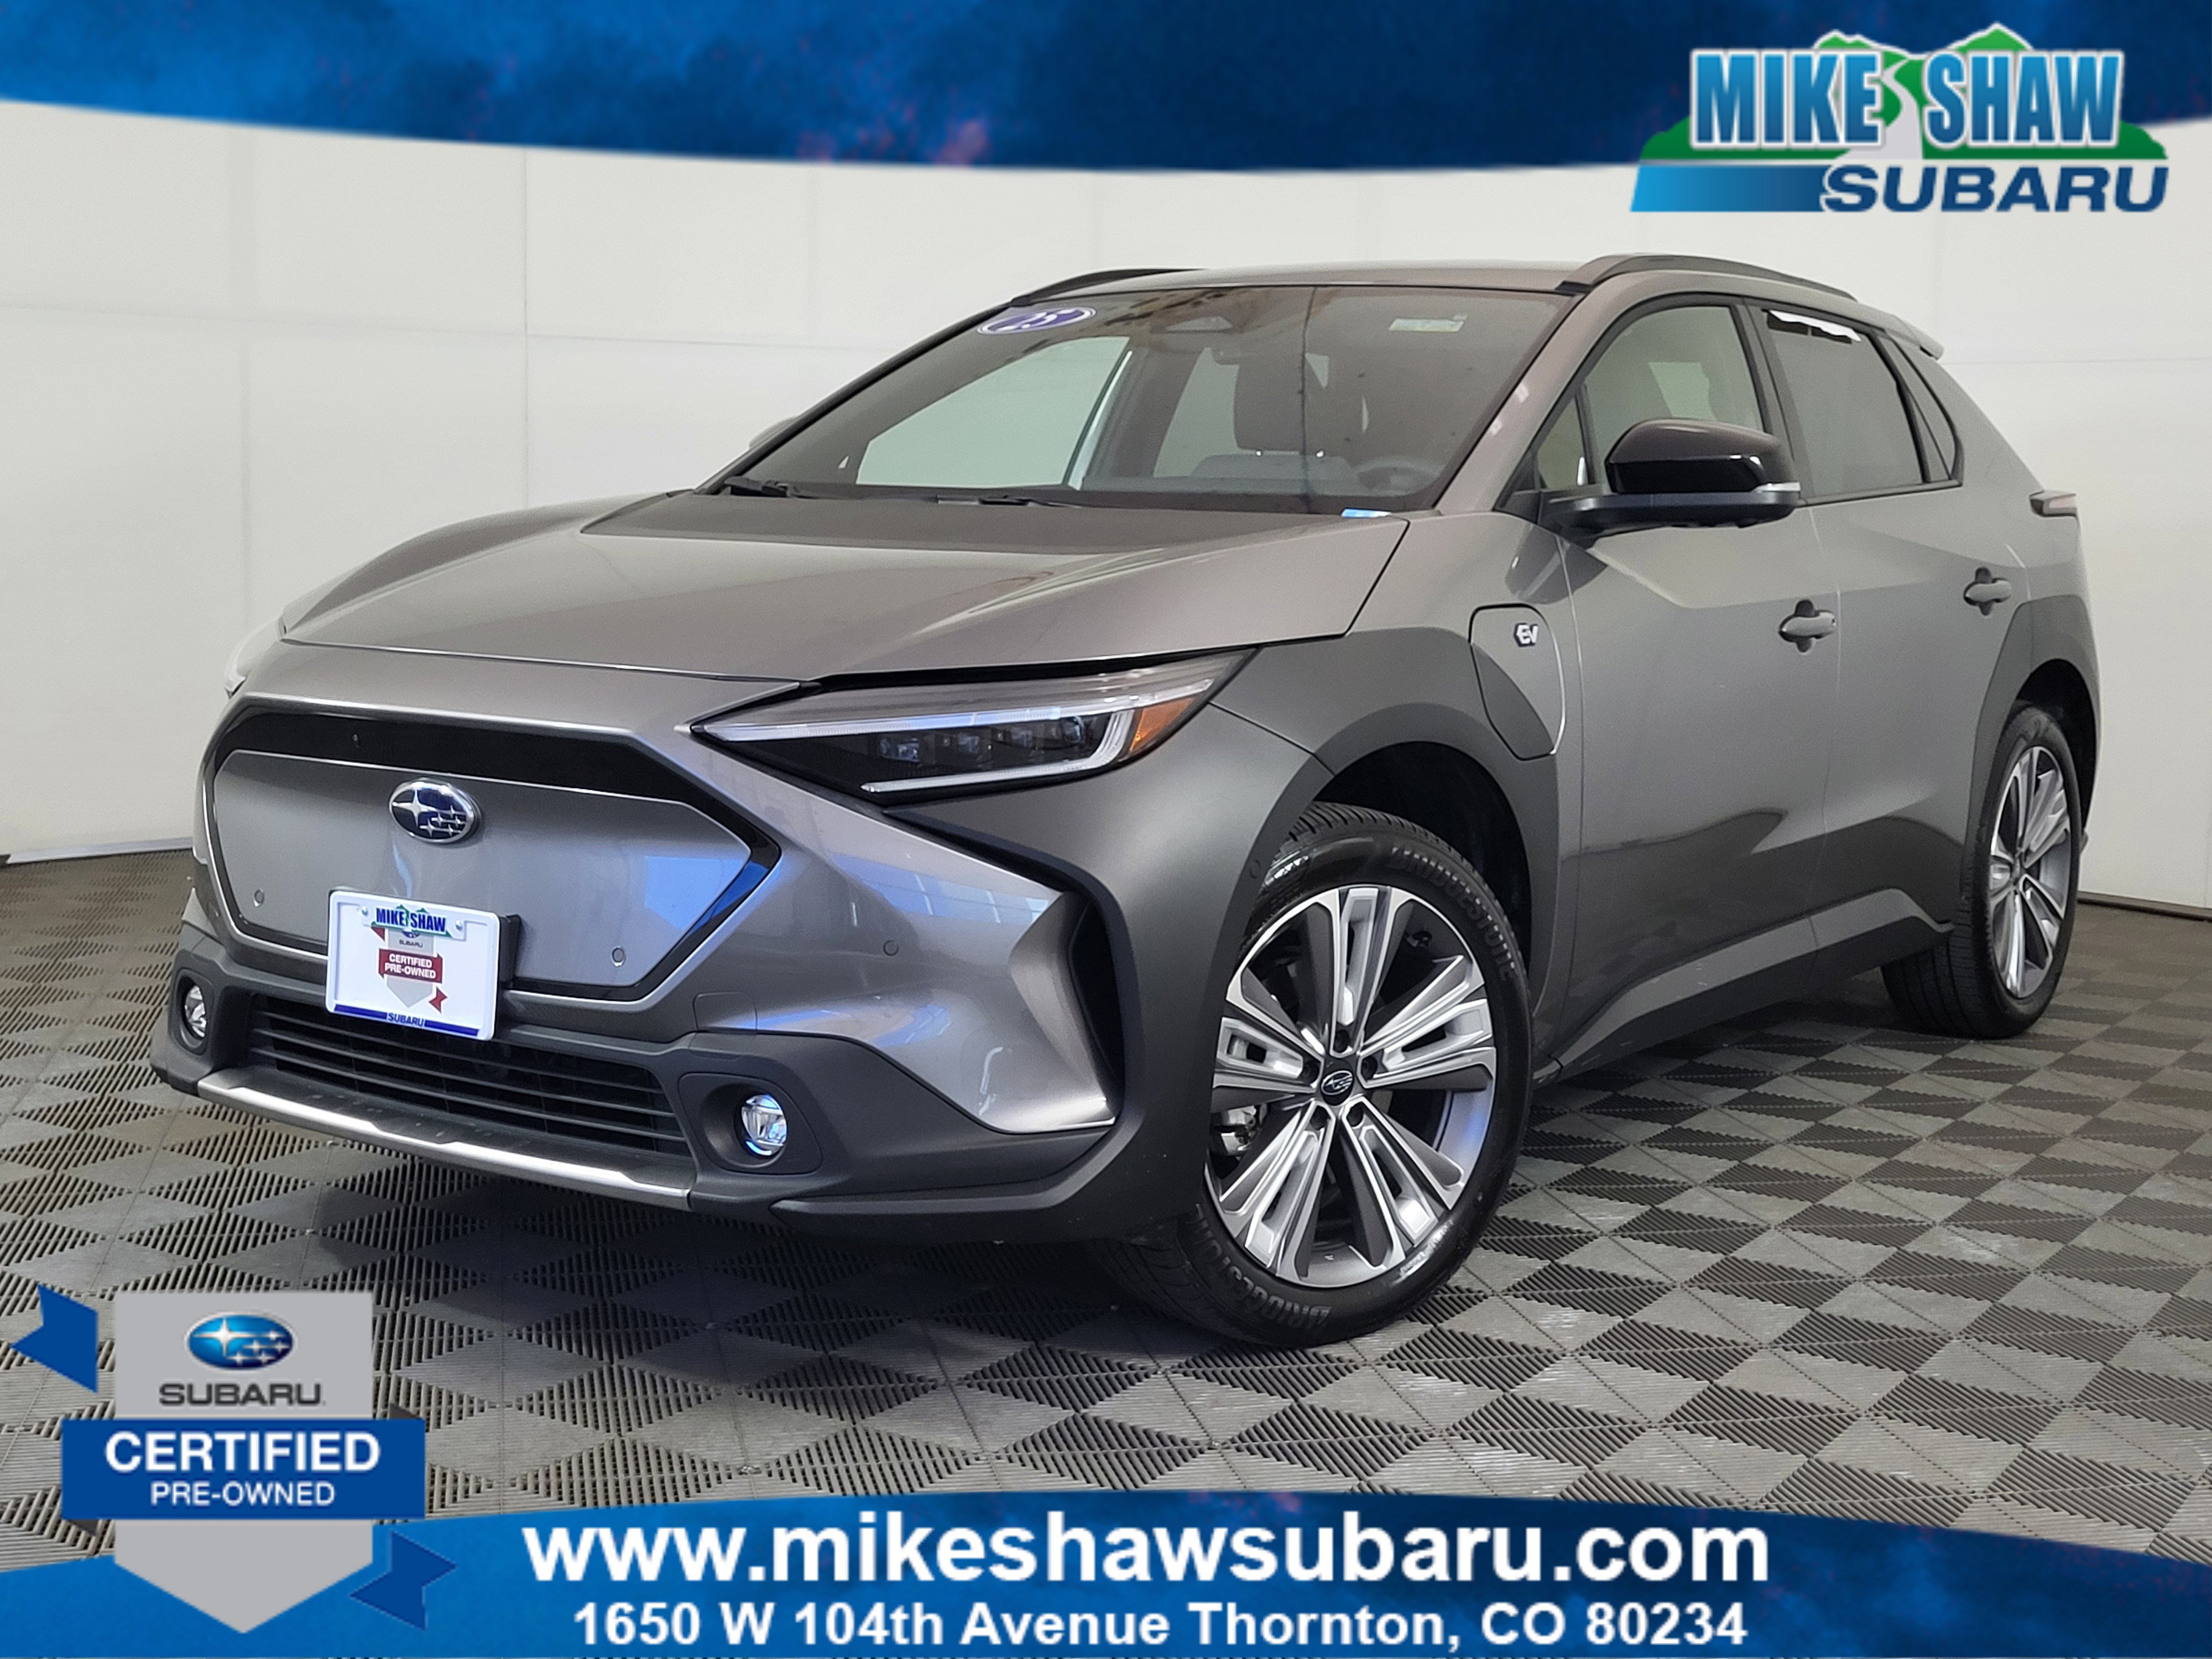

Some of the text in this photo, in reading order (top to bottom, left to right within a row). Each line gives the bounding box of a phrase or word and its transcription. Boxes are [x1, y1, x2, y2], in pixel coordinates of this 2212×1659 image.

[1515, 623, 1539, 646] EV
[376, 907, 446, 932] MIKE SHAW
[399, 939, 423, 948] SUBARU
[389, 953, 432, 968] CERTIFIED
[384, 962, 436, 979] PRE-OWNED
[388, 1013, 425, 1027] SUBARU
